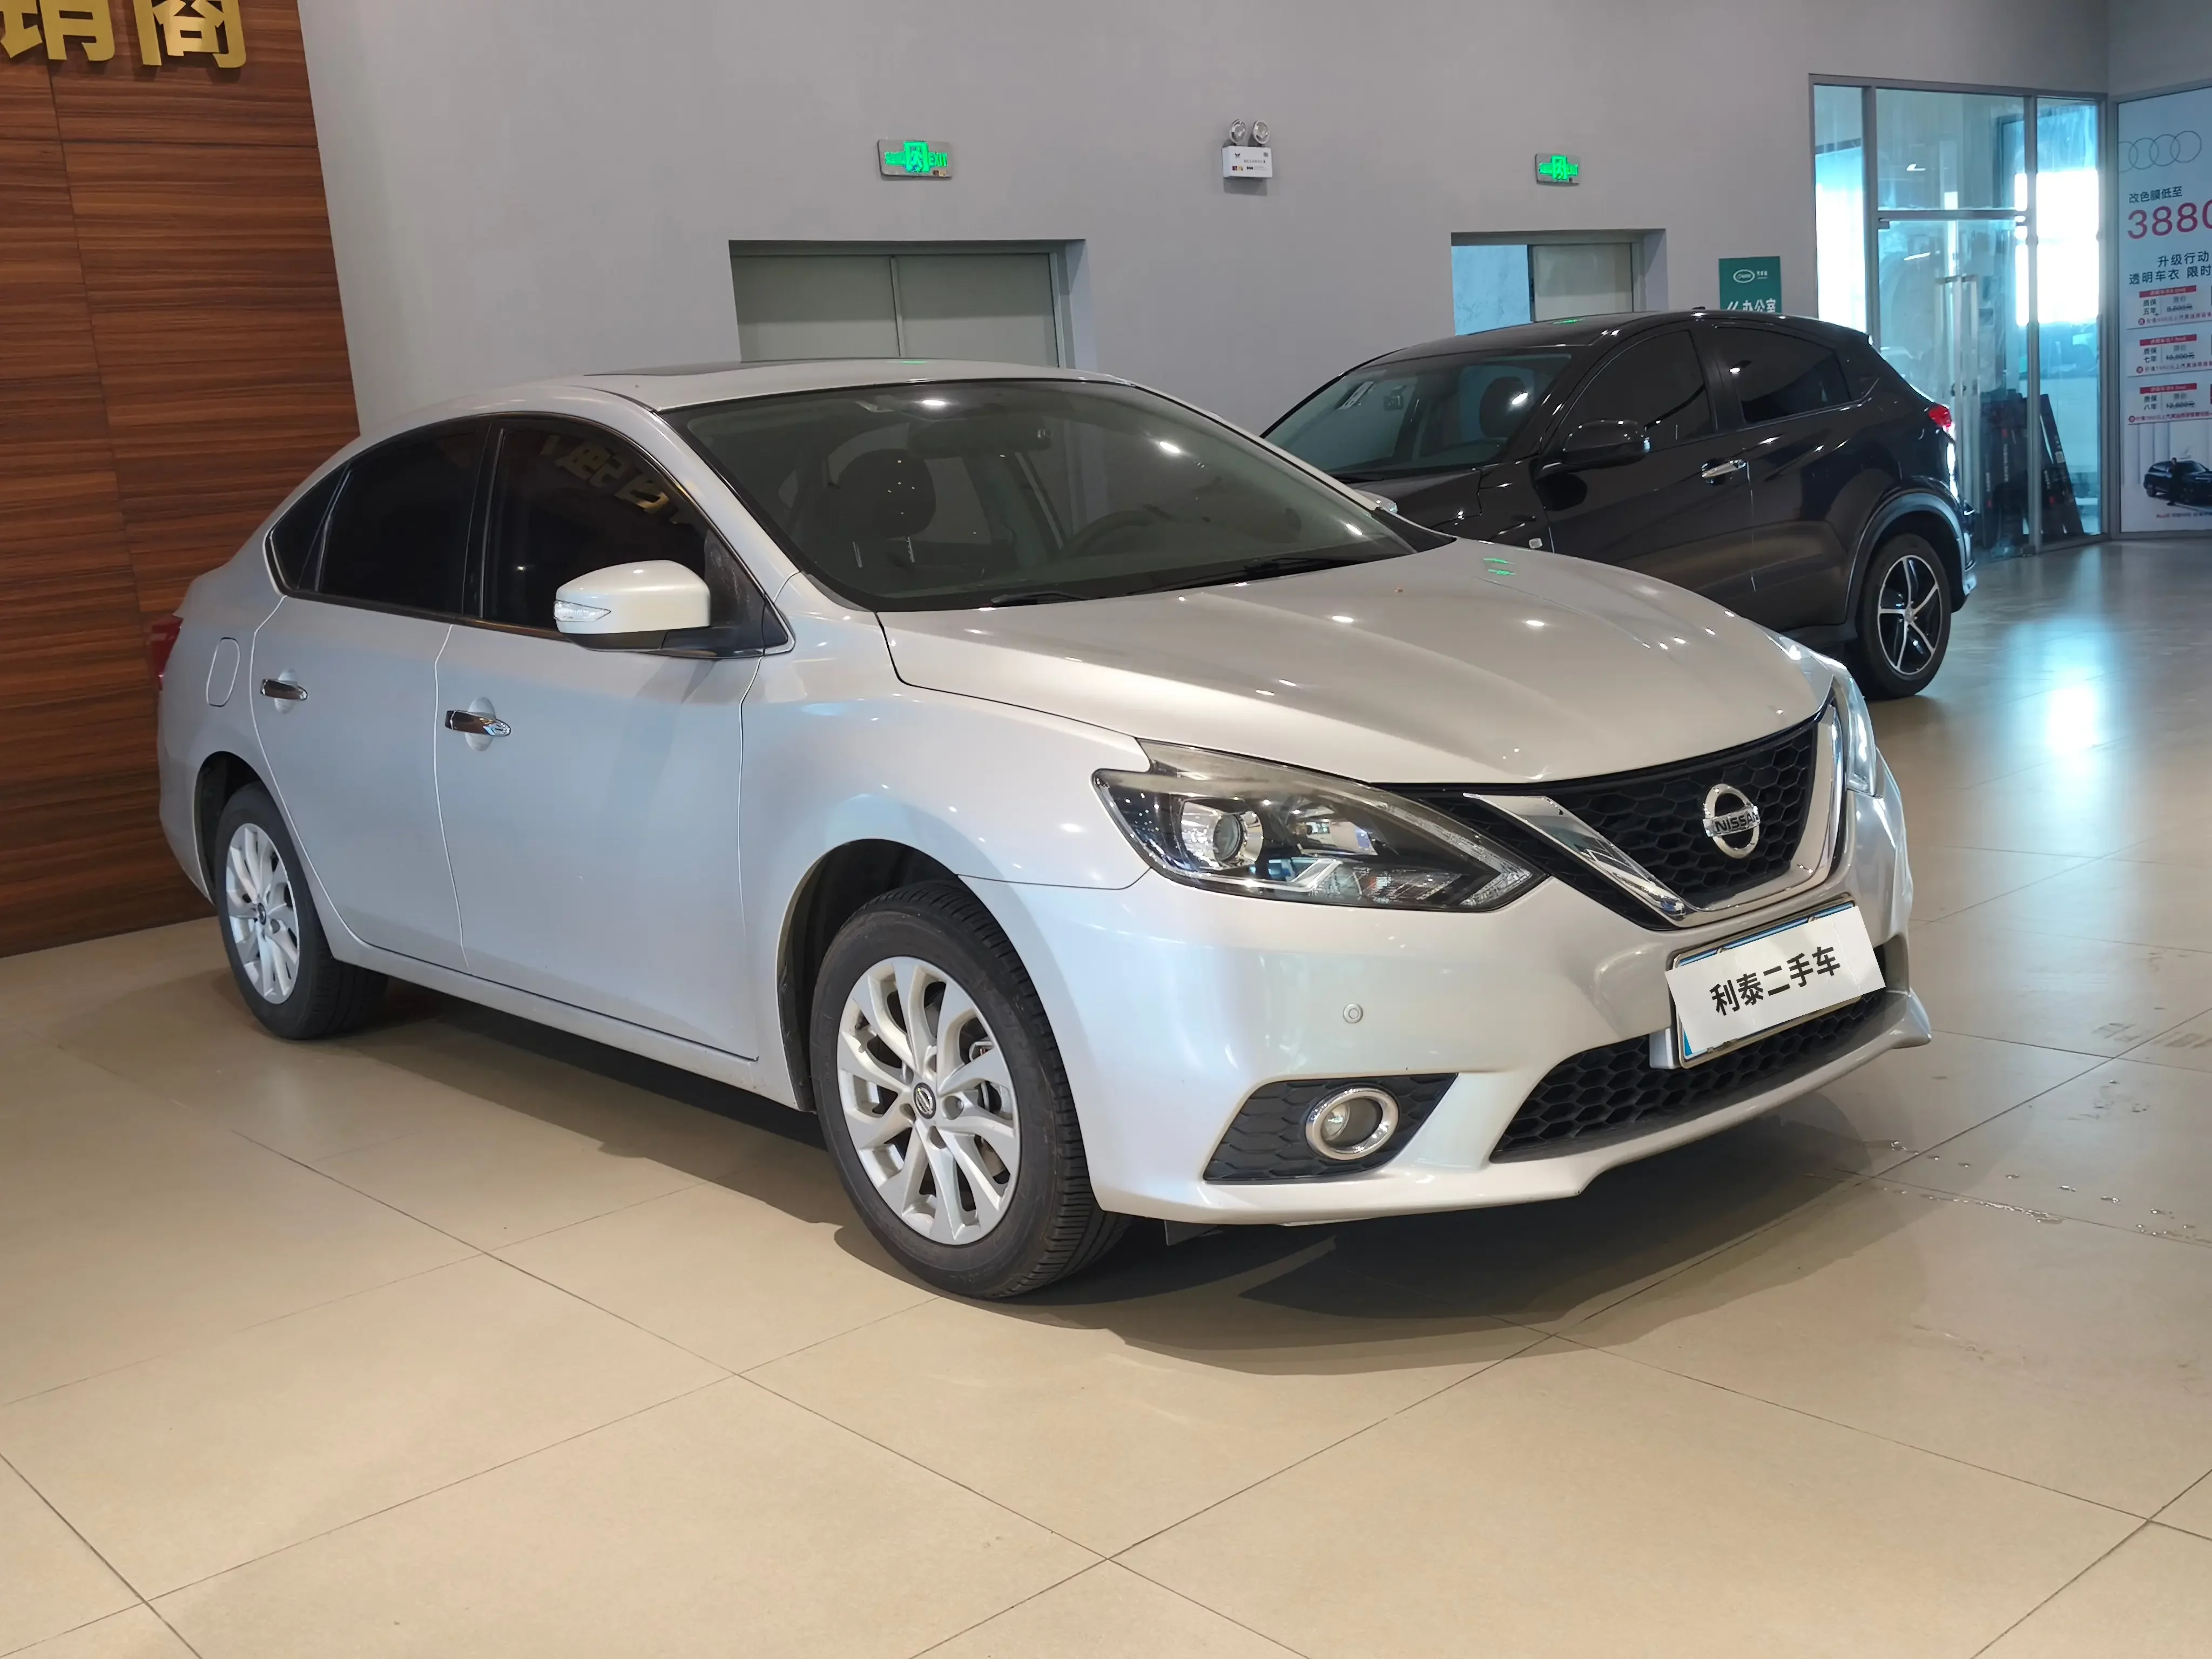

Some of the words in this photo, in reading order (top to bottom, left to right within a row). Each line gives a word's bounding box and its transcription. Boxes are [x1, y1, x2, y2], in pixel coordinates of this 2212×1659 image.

[2128, 186, 2183, 204] 改色膜低至
[2157, 250, 2209, 268] 升级行动
[2129, 269, 2180, 285] 透明车衣
[1742, 298, 1776, 313] 办公室
[1715, 811, 1759, 832] NISSAN
[1709, 946, 1841, 1016] 利泰二手车
